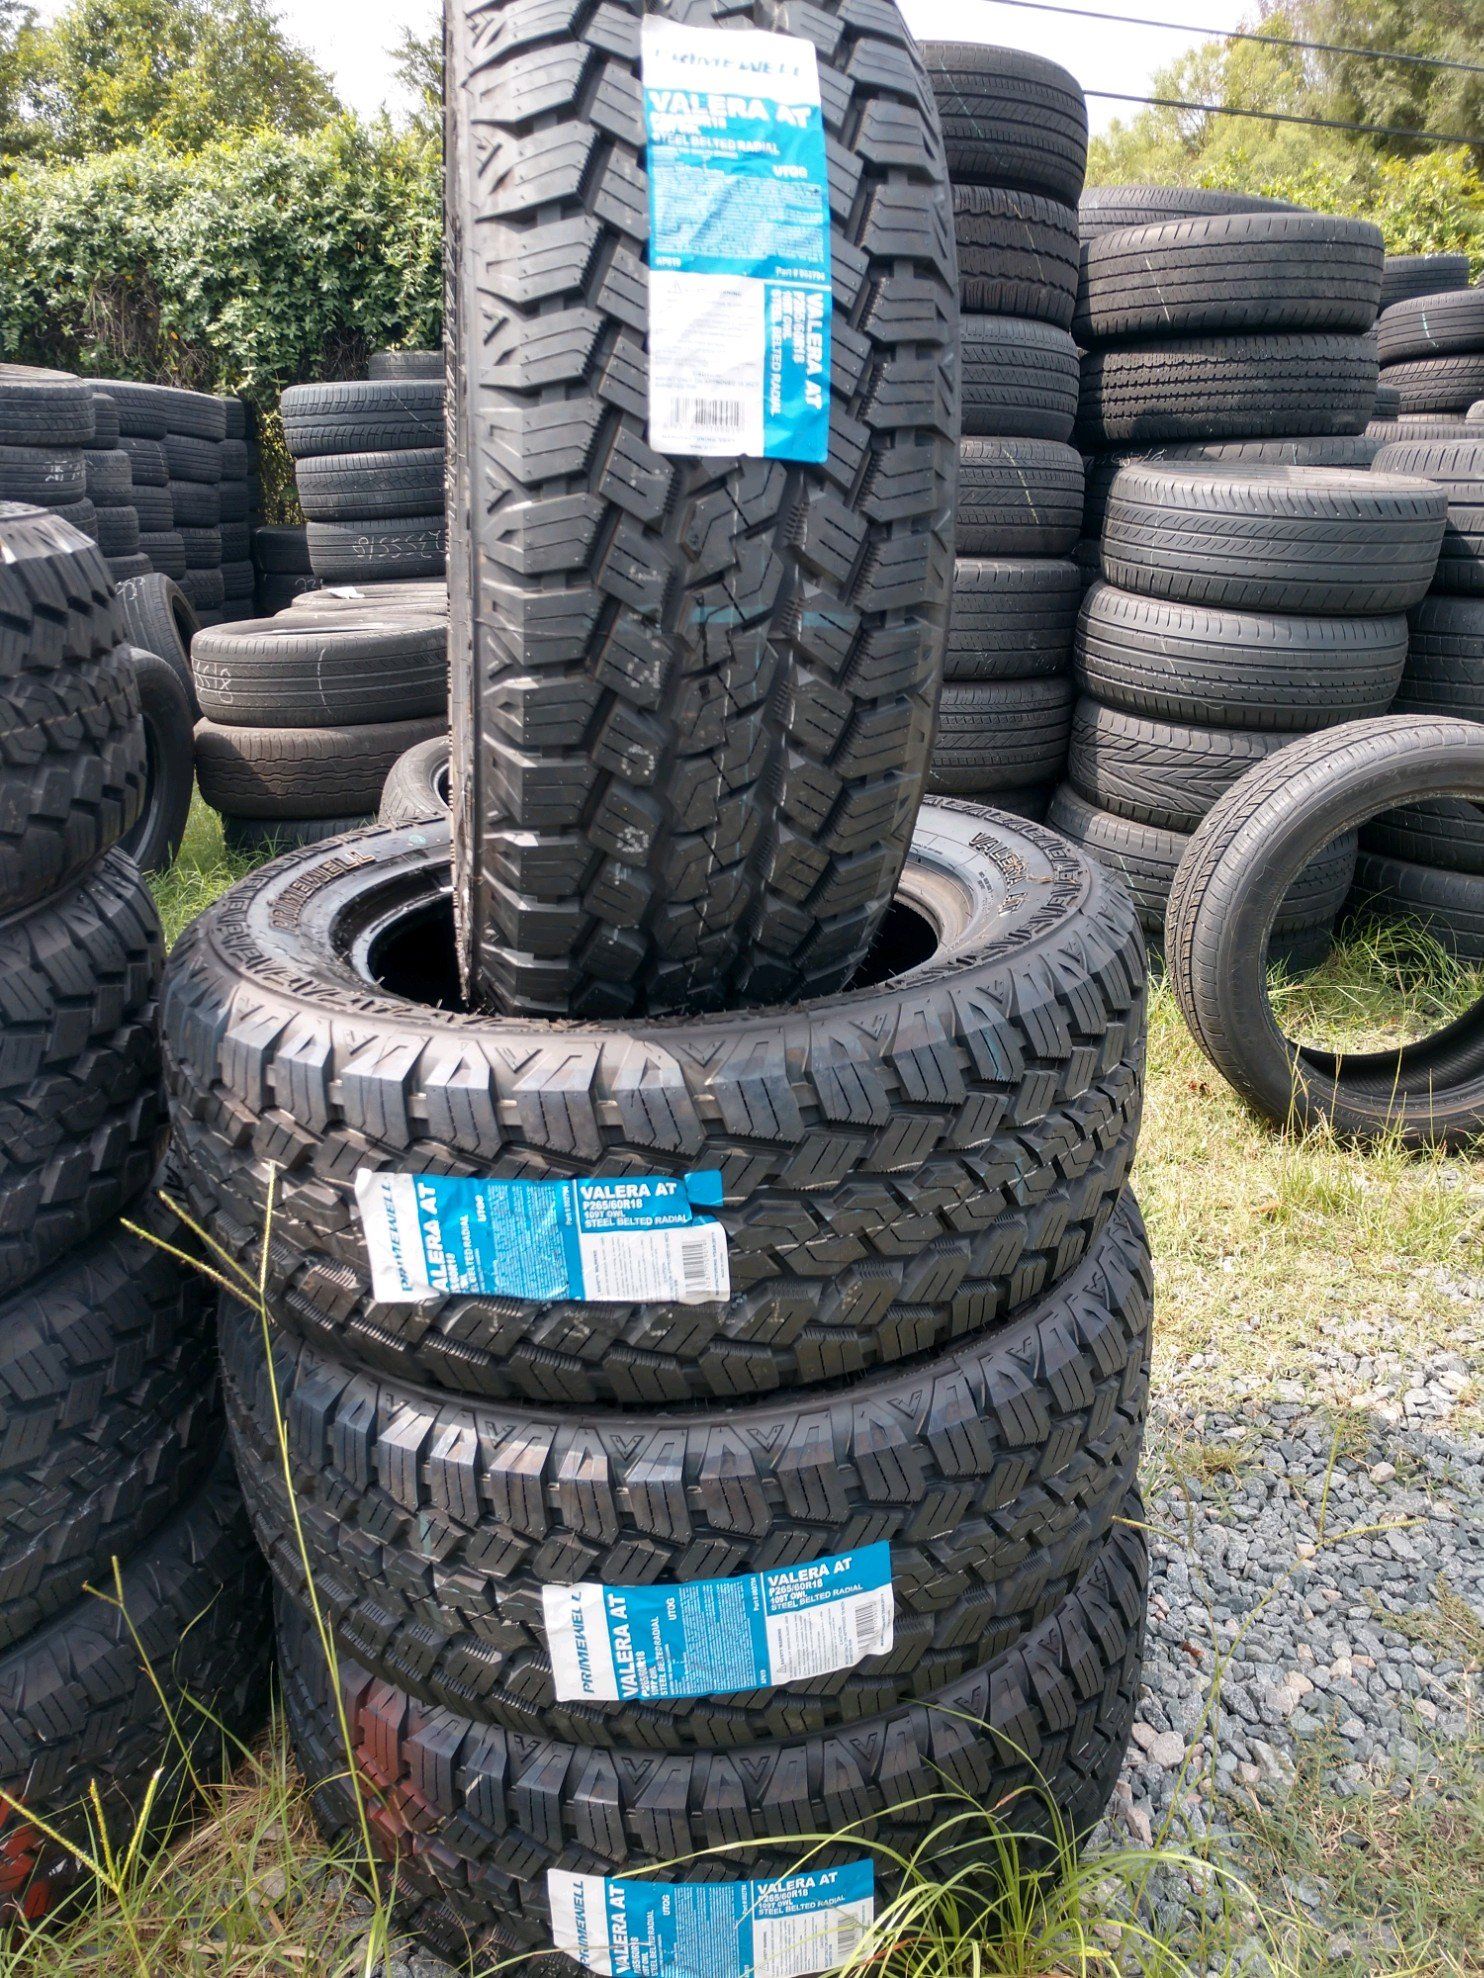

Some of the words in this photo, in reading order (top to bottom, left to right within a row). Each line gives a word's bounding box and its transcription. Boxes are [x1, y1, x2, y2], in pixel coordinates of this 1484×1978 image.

[648, 91, 770, 121] VALERA
[776, 104, 812, 128] AT
[770, 325, 783, 371] BELTED
[806, 292, 824, 376] VALERA
[770, 373, 782, 417] RADIAL
[804, 379, 823, 410] AT
[969, 832, 1028, 892] VALERA
[267, 849, 376, 937] PRIMEWELL
[418, 1182, 438, 1215] AT
[580, 1183, 650, 1200] VALERA
[655, 1182, 677, 1196] AT
[582, 1199, 643, 1210] P265/60R18
[584, 1210, 606, 1219] 109T
[606, 1210, 626, 1218] OWL
[584, 1216, 615, 1228] STEEL
[616, 1215, 653, 1227] BELTED
[654, 1213, 688, 1225] RADIAL
[460, 1213, 473, 1248] RADIAL
[423, 1219, 450, 1292] ALERA
[768, 1563, 829, 1587] VALERA
[834, 1557, 852, 1574] AT
[769, 1579, 823, 1597] P265/60R18
[770, 1593, 789, 1604] 109T
[790, 1591, 808, 1601] OWL
[771, 1598, 798, 1611] STEEL
[800, 1591, 831, 1606] BELTED
[832, 1583, 863, 1598] RADIAL
[607, 1593, 628, 1619] AT
[571, 1591, 594, 1694] PRIMEWELL
[651, 1616, 663, 1646] RADIAL
[612, 1623, 638, 1697] VALERA
[658, 1671, 668, 1696] STEEL
[609, 1884, 626, 1910] AT
[757, 1876, 816, 1895] VALERA
[819, 1871, 838, 1885] AT
[661, 1894, 670, 1916] UTQG
[758, 1907, 784, 1916] STEEL
[785, 1901, 816, 1913] BELTED
[816, 1895, 846, 1907] RADIAL
[777, 1899, 794, 1907] OWL
[573, 1880, 591, 1967] PRIMEWELL
[646, 1910, 655, 1935] RADIAL
[611, 1912, 631, 1974] VALERA
